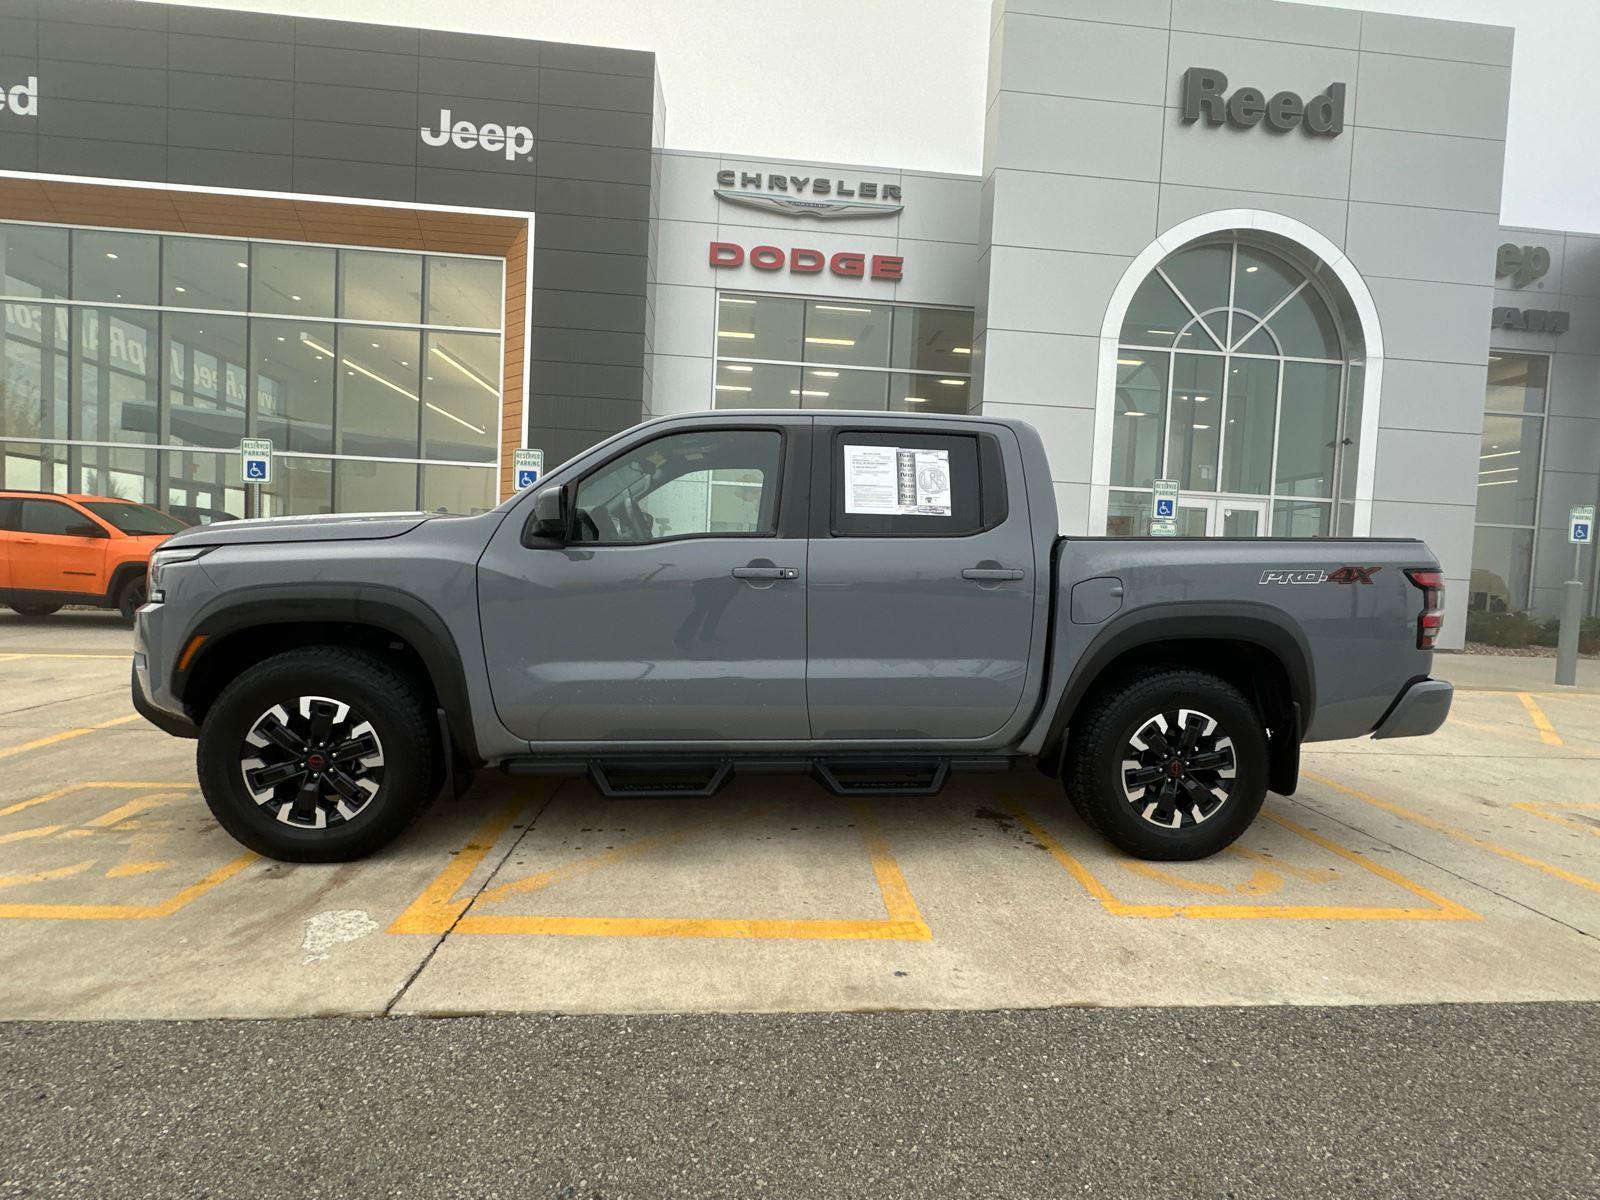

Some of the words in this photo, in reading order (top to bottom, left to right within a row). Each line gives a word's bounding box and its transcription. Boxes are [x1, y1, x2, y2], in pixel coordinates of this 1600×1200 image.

[1182, 67, 1346, 138] Reed
[420, 108, 534, 161] Jeep
[717, 170, 902, 200] CHRYSLER
[709, 241, 904, 281] DODGE
[243, 450, 270, 458] PARKING
[244, 442, 270, 450] RESERVED
[516, 452, 541, 460] RESERVED
